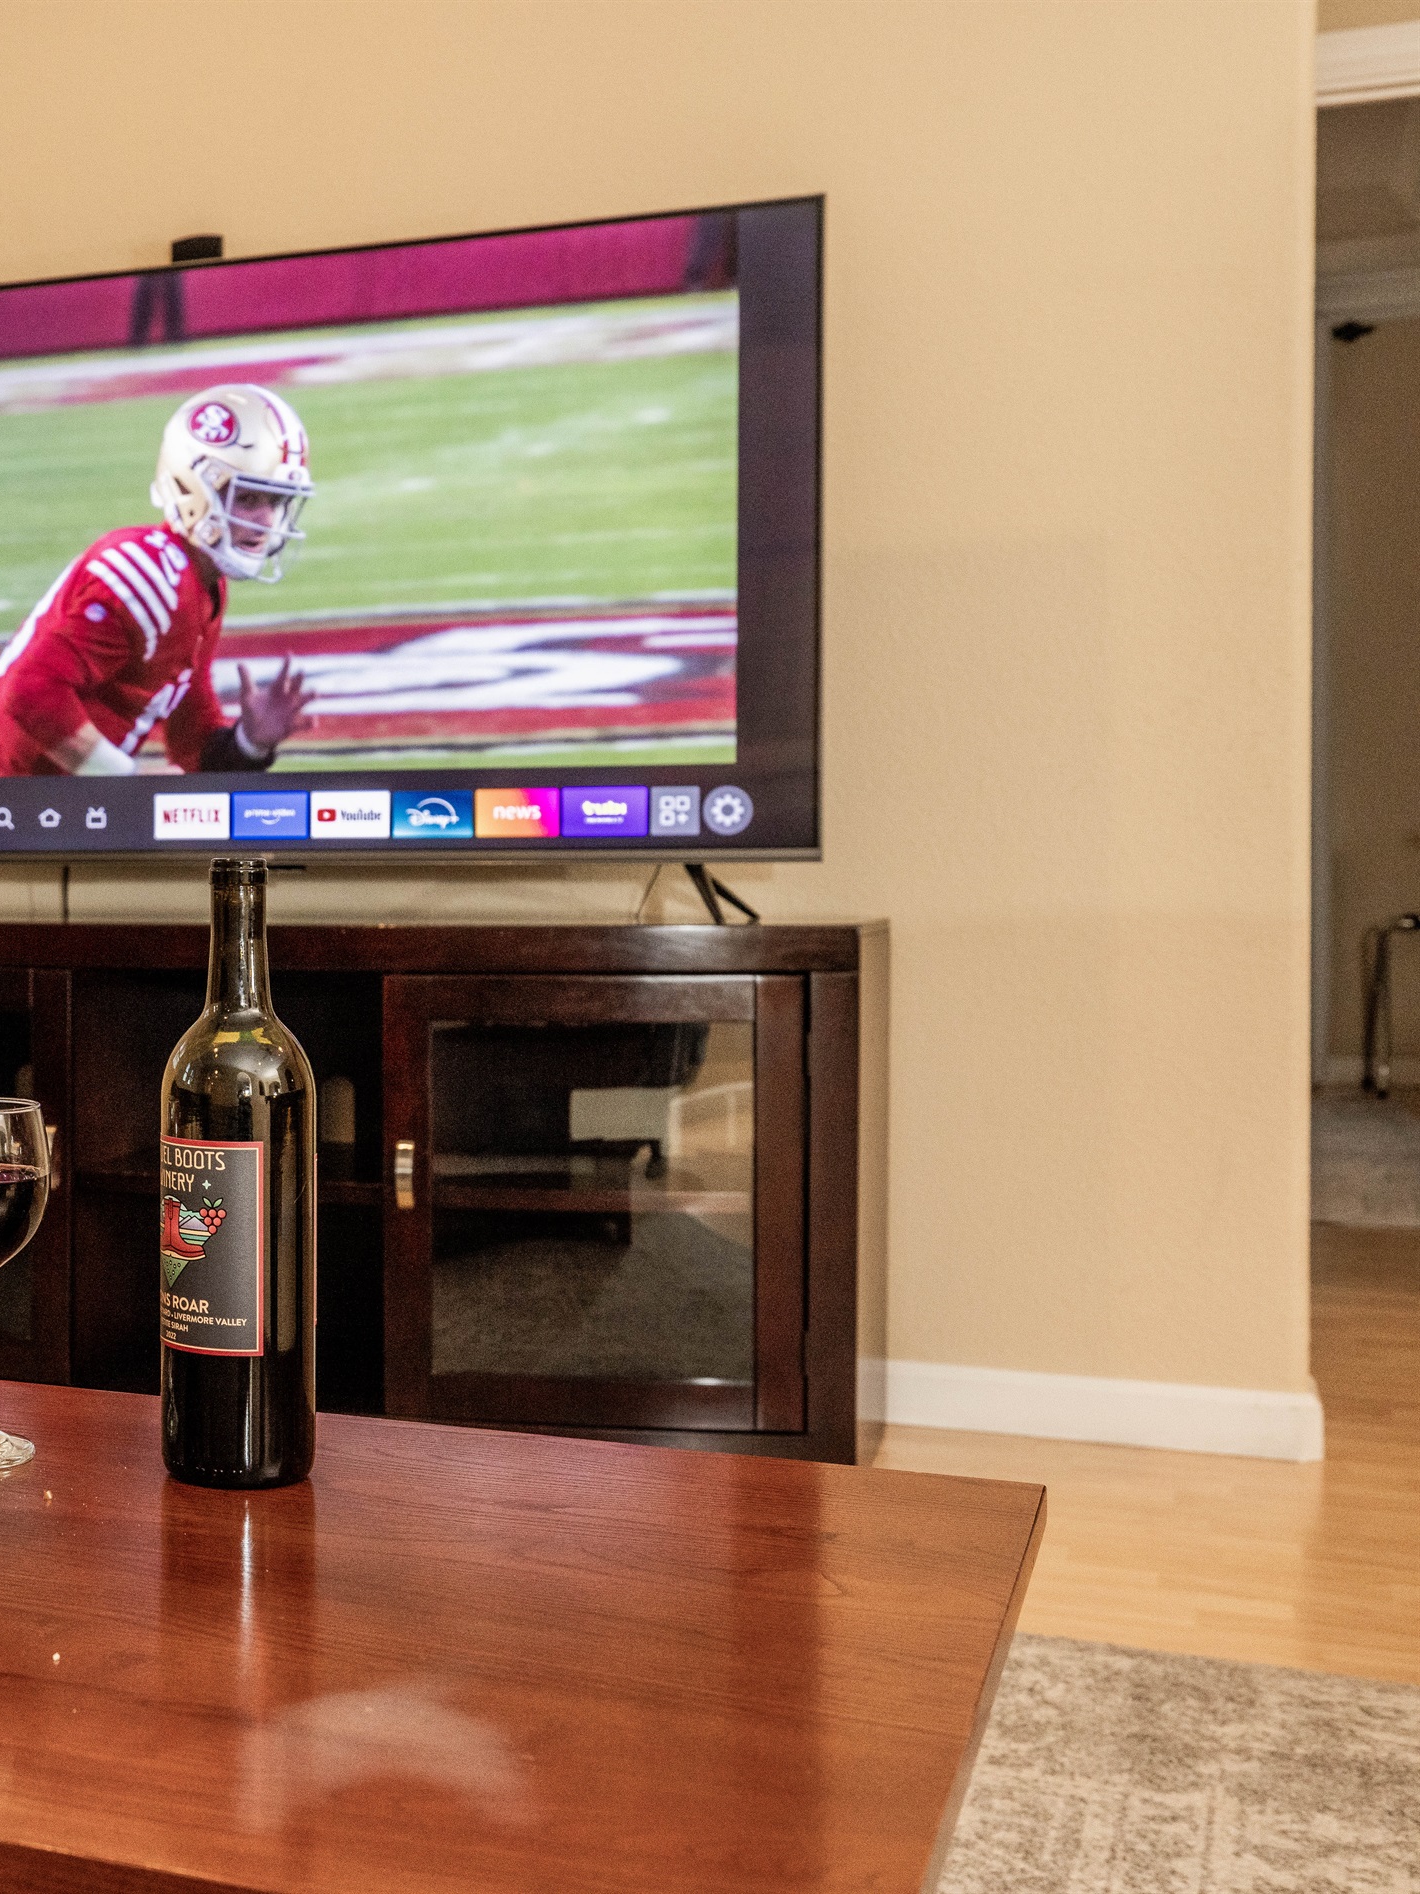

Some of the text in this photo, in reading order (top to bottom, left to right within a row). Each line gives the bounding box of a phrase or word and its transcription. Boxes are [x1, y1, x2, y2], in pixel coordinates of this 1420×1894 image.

[163, 807, 220, 823] NETFLIX
[340, 808, 381, 821] YouTube
[492, 805, 542, 820] news
[161, 1145, 226, 1171] EL BOOTS
[172, 1295, 209, 1314] ROAR
[171, 1321, 189, 1332] SIRAH
[173, 1312, 214, 1325] LIVERMORE
[215, 1317, 247, 1327] VALLEY
